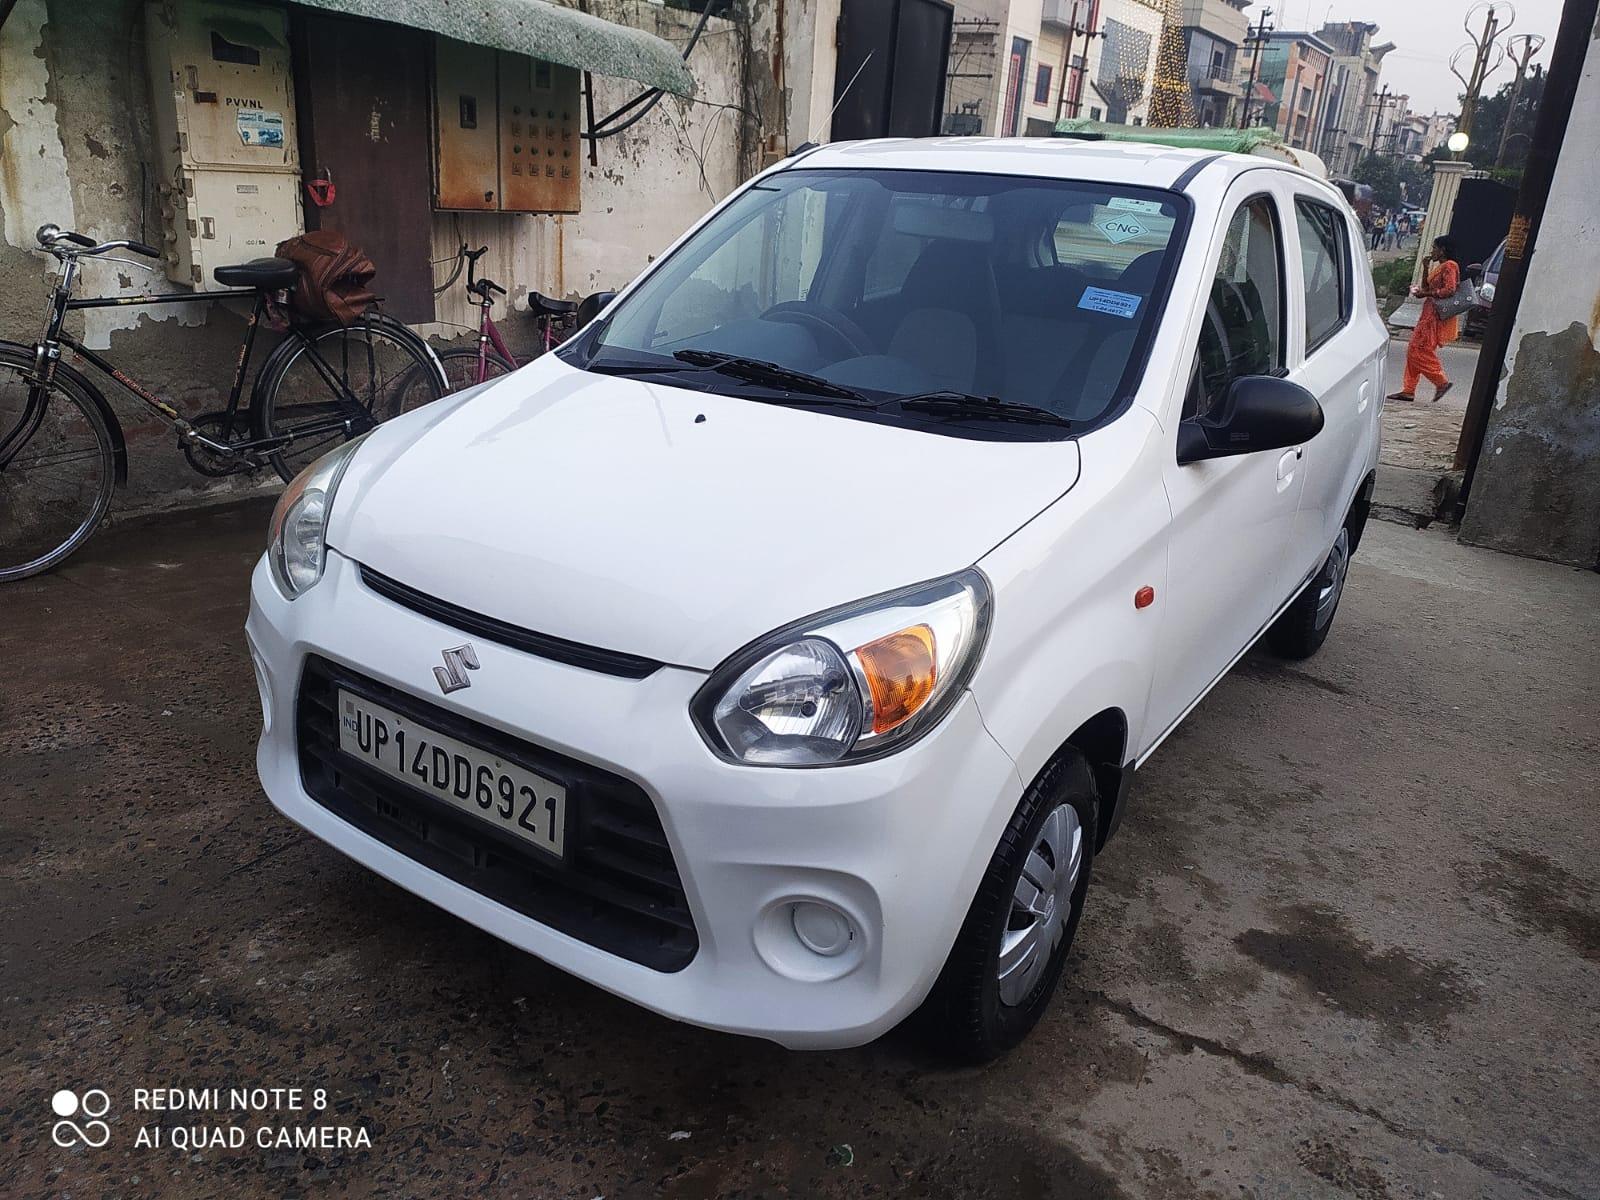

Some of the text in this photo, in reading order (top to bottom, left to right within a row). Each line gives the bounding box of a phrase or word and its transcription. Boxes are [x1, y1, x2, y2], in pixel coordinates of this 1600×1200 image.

[225, 97, 264, 109] PVVNL
[1105, 222, 1140, 234] CNG
[343, 715, 358, 732] IND
[357, 710, 557, 842] UP14DD6921
